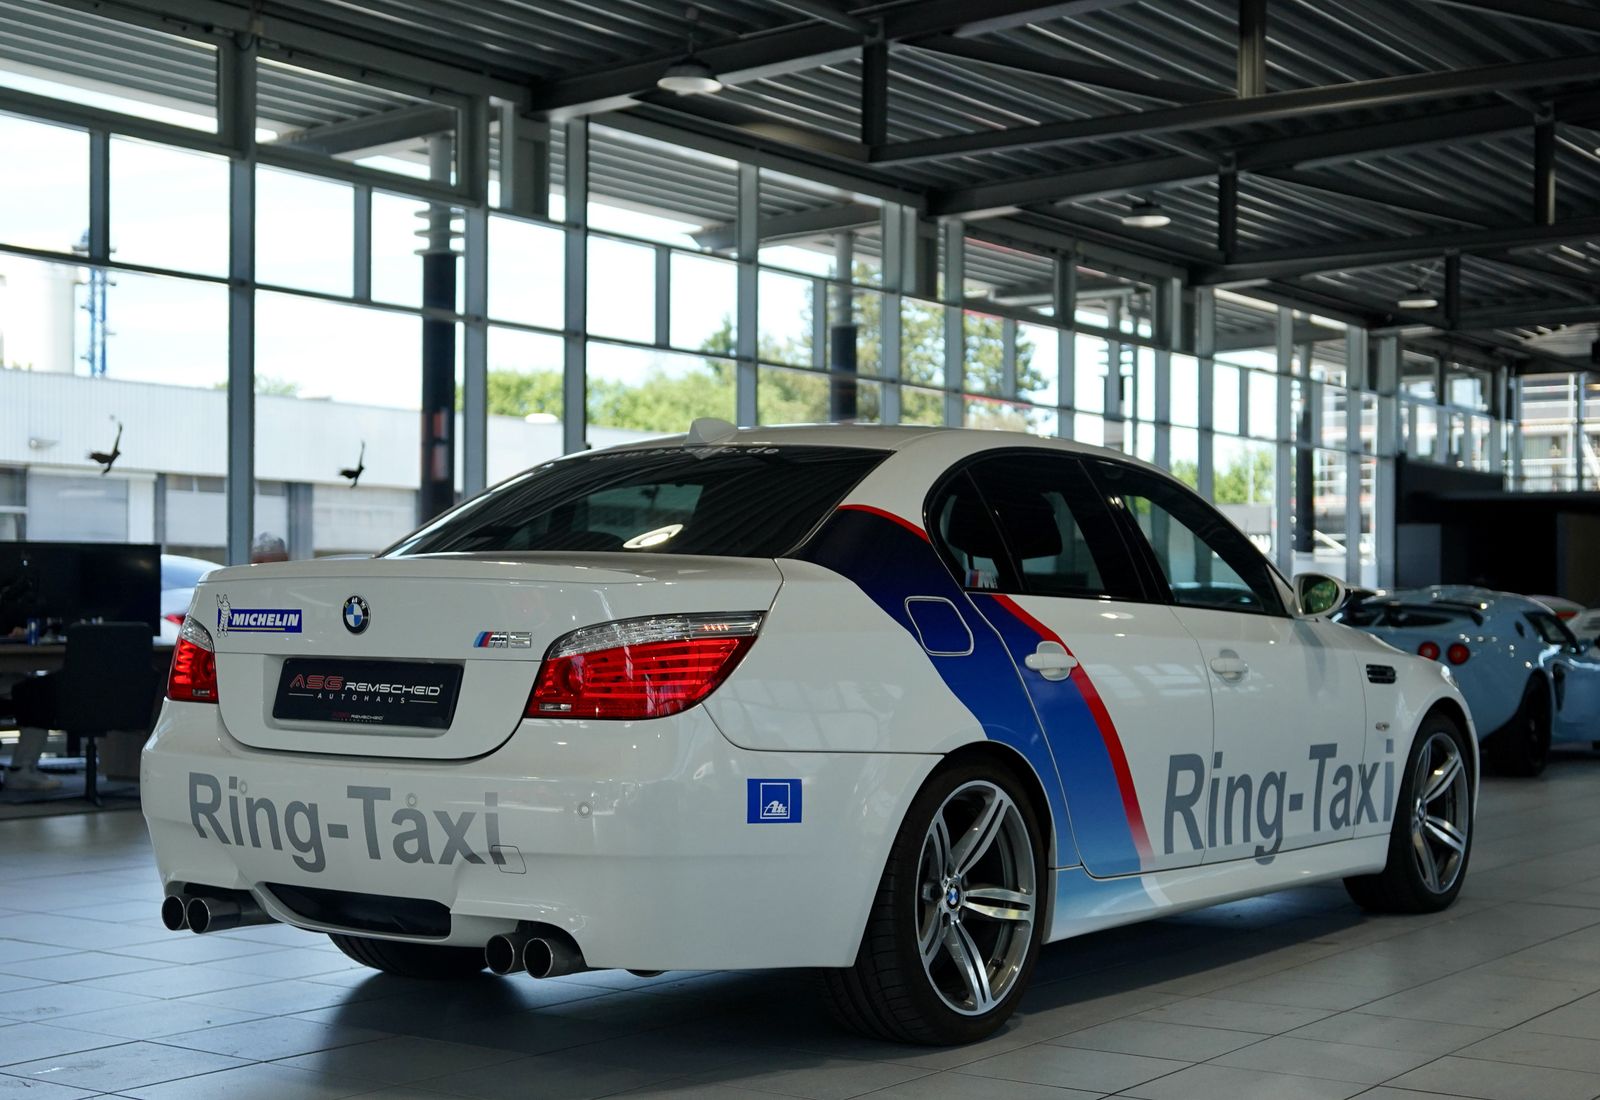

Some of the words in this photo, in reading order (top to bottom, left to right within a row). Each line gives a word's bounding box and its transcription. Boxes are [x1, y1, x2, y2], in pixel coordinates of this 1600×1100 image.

[232, 613, 299, 626] MICHELIN
[488, 631, 532, 648] M5
[289, 673, 344, 691] ASG
[345, 681, 441, 696] REMSCHEID
[317, 693, 405, 704] AUTOHAUS
[1164, 738, 1394, 865] Ring-Taxi
[188, 771, 507, 873] Ring-Taxi
